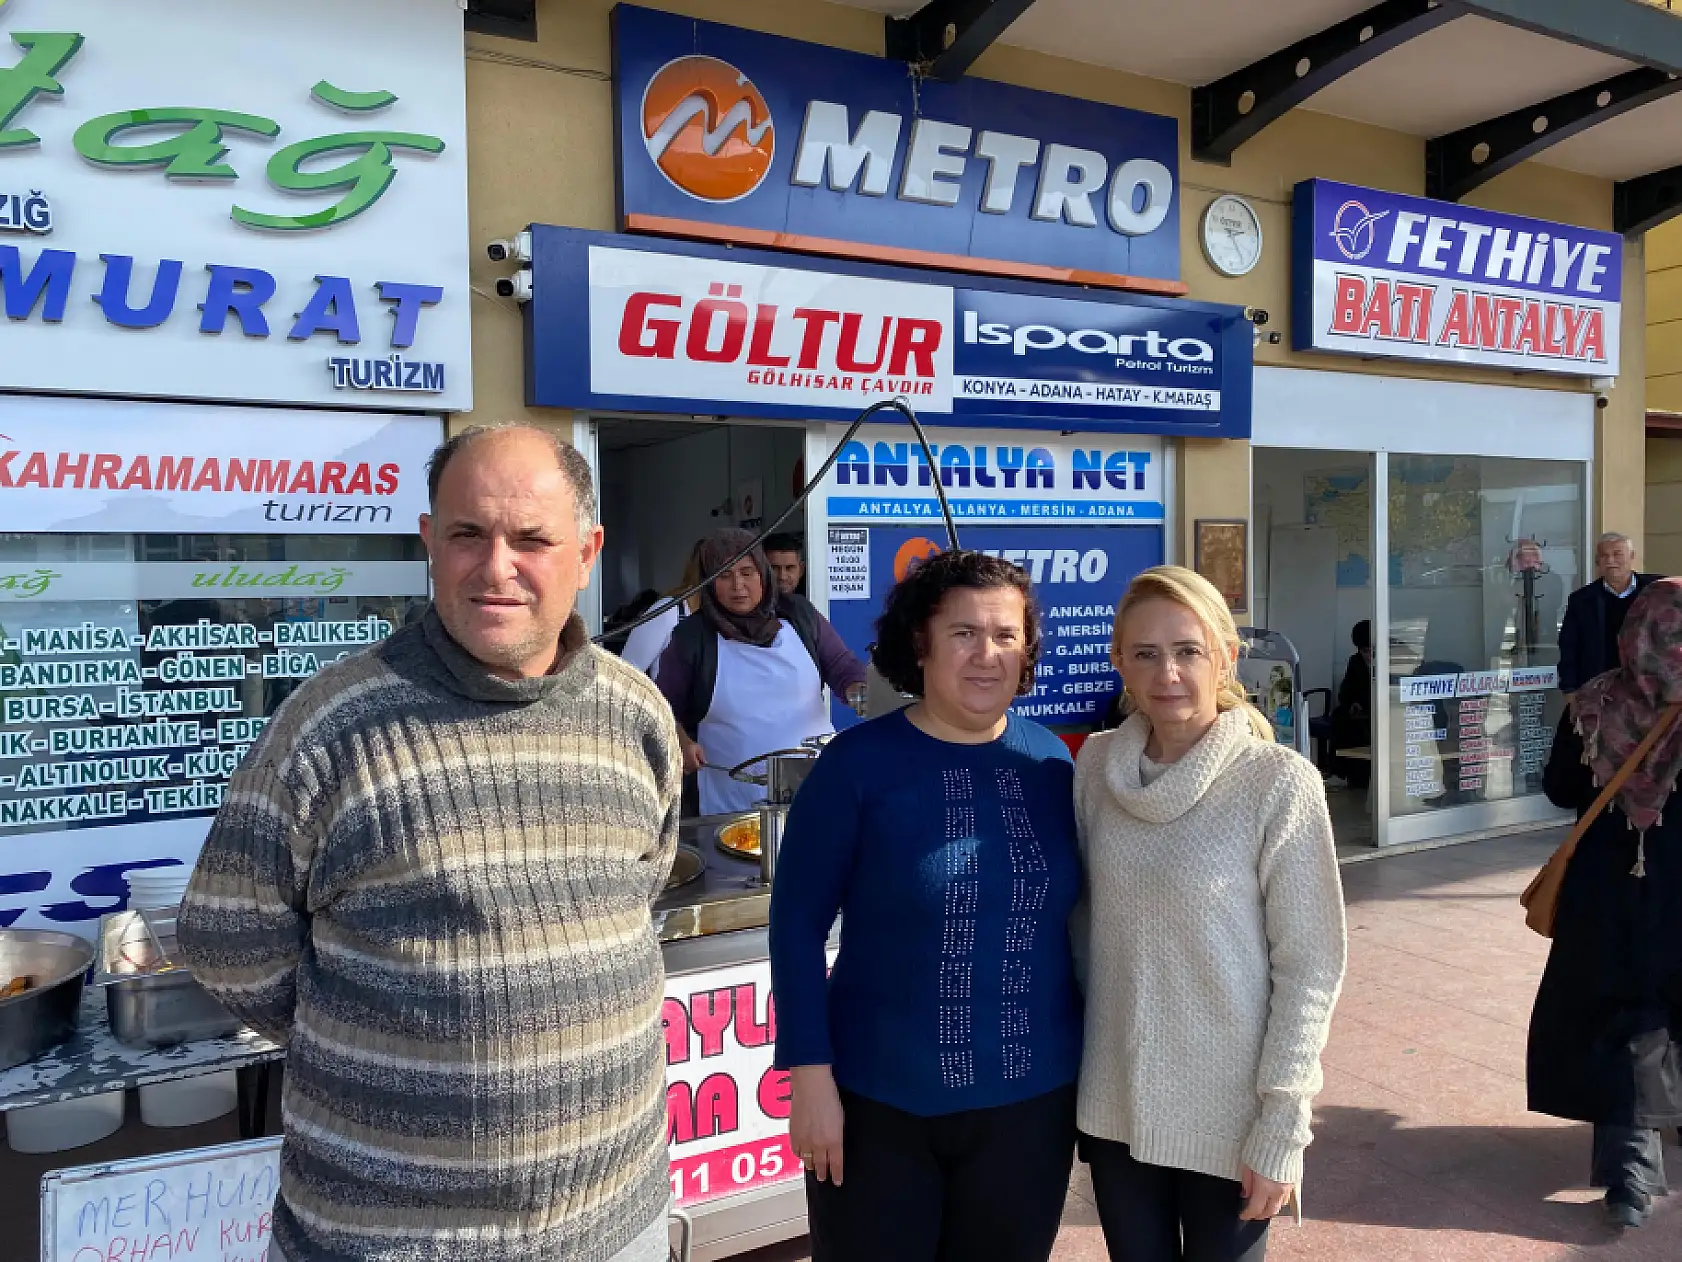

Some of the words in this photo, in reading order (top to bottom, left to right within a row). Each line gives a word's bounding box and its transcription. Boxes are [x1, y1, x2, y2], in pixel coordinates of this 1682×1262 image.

[790, 97, 1175, 236] METRO
[0, 245, 444, 348] MURAT
[617, 281, 943, 378] GÖLTUR
[963, 310, 1214, 363] Isparta
[1327, 271, 1437, 347] BATI
[1434, 286, 1609, 365] ANTALYA
[328, 352, 446, 392] TURİZM
[1115, 357, 1162, 372] Petrol
[1166, 361, 1214, 376] Turizm
[860, 377, 934, 396] ÇAVDIR
[962, 378, 1017, 396] KONYA
[1029, 384, 1083, 400] ADANA
[1095, 390, 1142, 404] HATAY
[1152, 392, 1213, 409] K.MARAŞ
[835, 440, 1056, 489] ANTALYA
[1071, 448, 1152, 490] NET
[262, 499, 392, 523] turizm
[858, 501, 932, 515] ANTALYA
[946, 503, 1008, 516] ALANYA
[1020, 503, 1076, 517] MERSİN
[1088, 505, 1134, 517] ADANA
[190, 564, 354, 595] uludağ
[1048, 604, 1116, 619] ANKARA
[22, 622, 131, 655] MANİSA
[145, 618, 259, 652] AKHİSAR
[274, 615, 393, 645] BALIKESİR
[0, 659, 142, 690] BANDIRMA
[159, 651, 245, 683] GÖNEN
[263, 648, 319, 678] BİGA
[1063, 680, 1115, 695] GEBZE
[5, 693, 100, 723] BURSA
[117, 686, 242, 719] İSTANBUL
[1010, 700, 1096, 717] MUKKALE
[50, 718, 200, 755] BURHANİYE
[15, 754, 170, 792] ALTINOLUK
[0, 791, 127, 826] NAKKALE
[732, 1143, 783, 1184] 05
